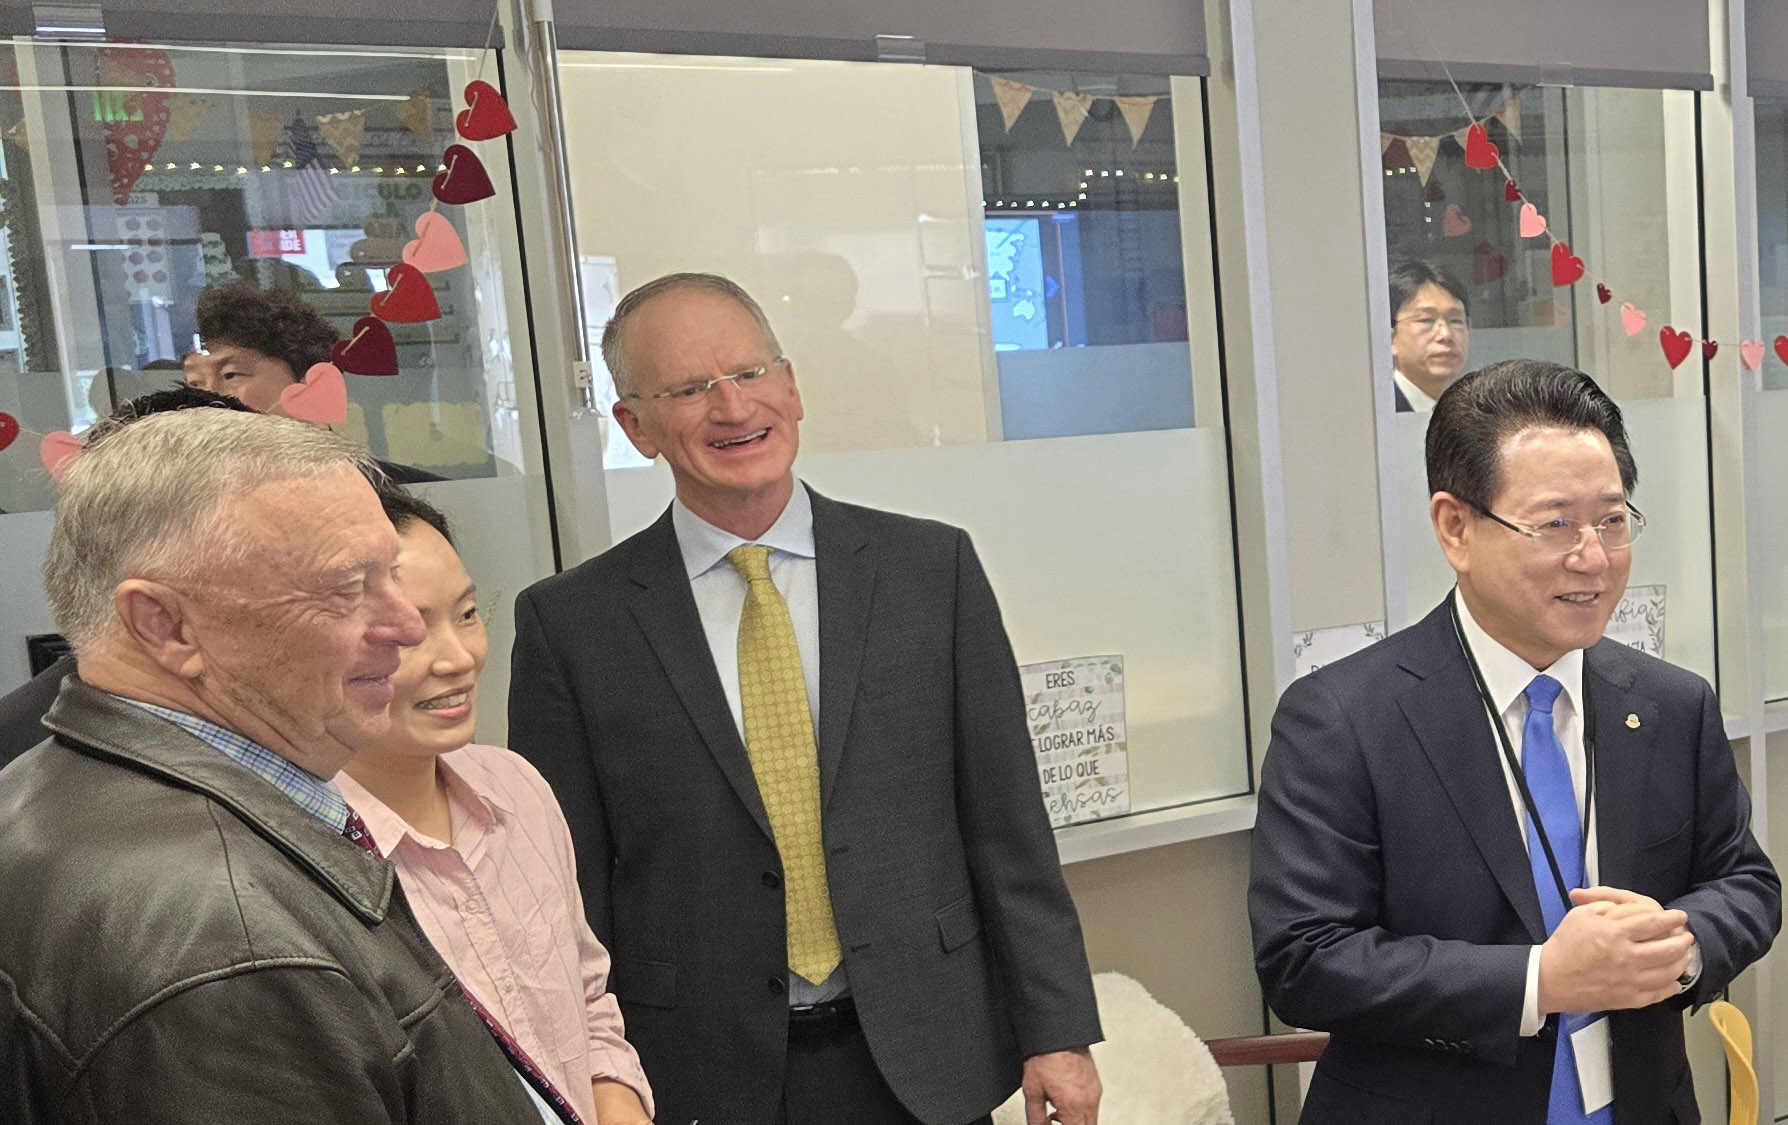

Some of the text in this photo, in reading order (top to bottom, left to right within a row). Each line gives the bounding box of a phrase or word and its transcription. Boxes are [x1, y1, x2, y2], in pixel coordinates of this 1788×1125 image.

[1045, 671, 1076, 690] ERES
[1028, 699, 1103, 730] capaz
[1038, 724, 1116, 753] LOGRAR MÁS
[1043, 759, 1100, 785] DE LO QUE
